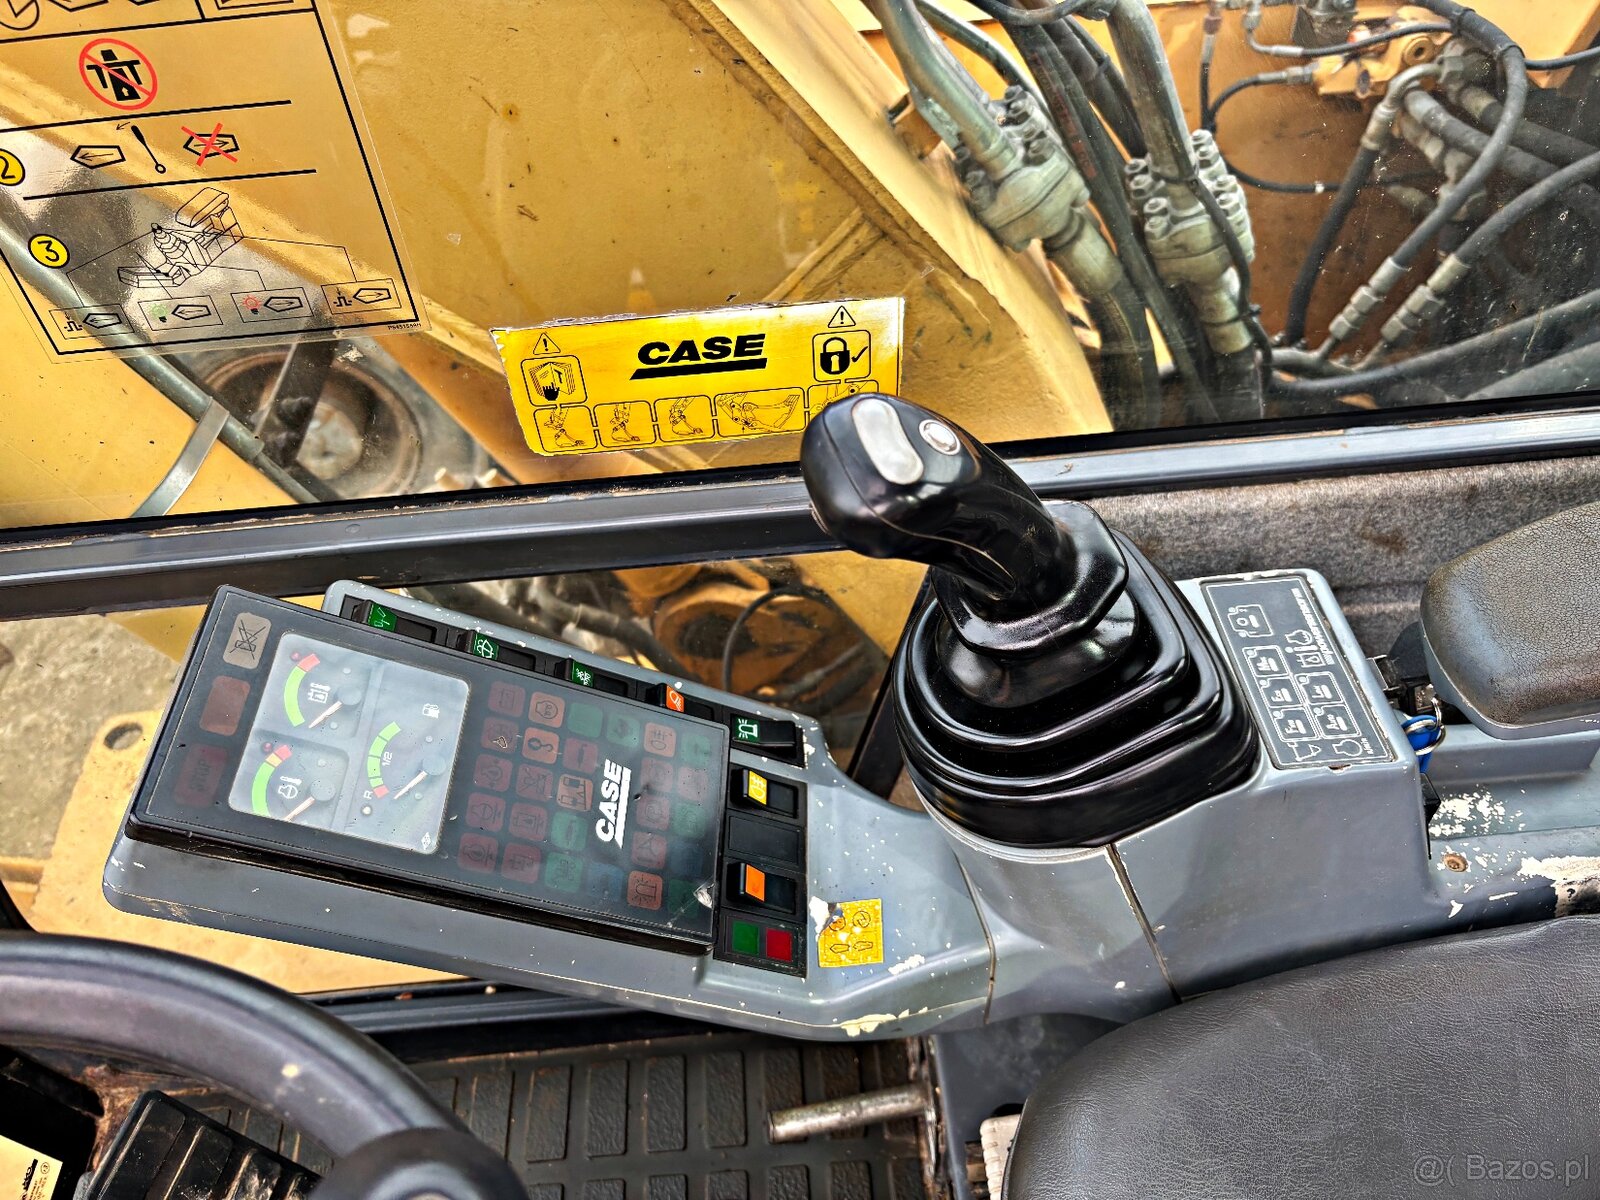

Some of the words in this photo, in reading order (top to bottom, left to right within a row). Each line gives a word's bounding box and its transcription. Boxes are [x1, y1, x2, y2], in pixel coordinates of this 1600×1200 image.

[0, 155, 15, 179] 2
[37, 239, 60, 262] 3
[637, 333, 766, 365] CASE
[382, 751, 393, 767] 1/2
[363, 790, 373, 800] R
[596, 758, 622, 842] CASE
